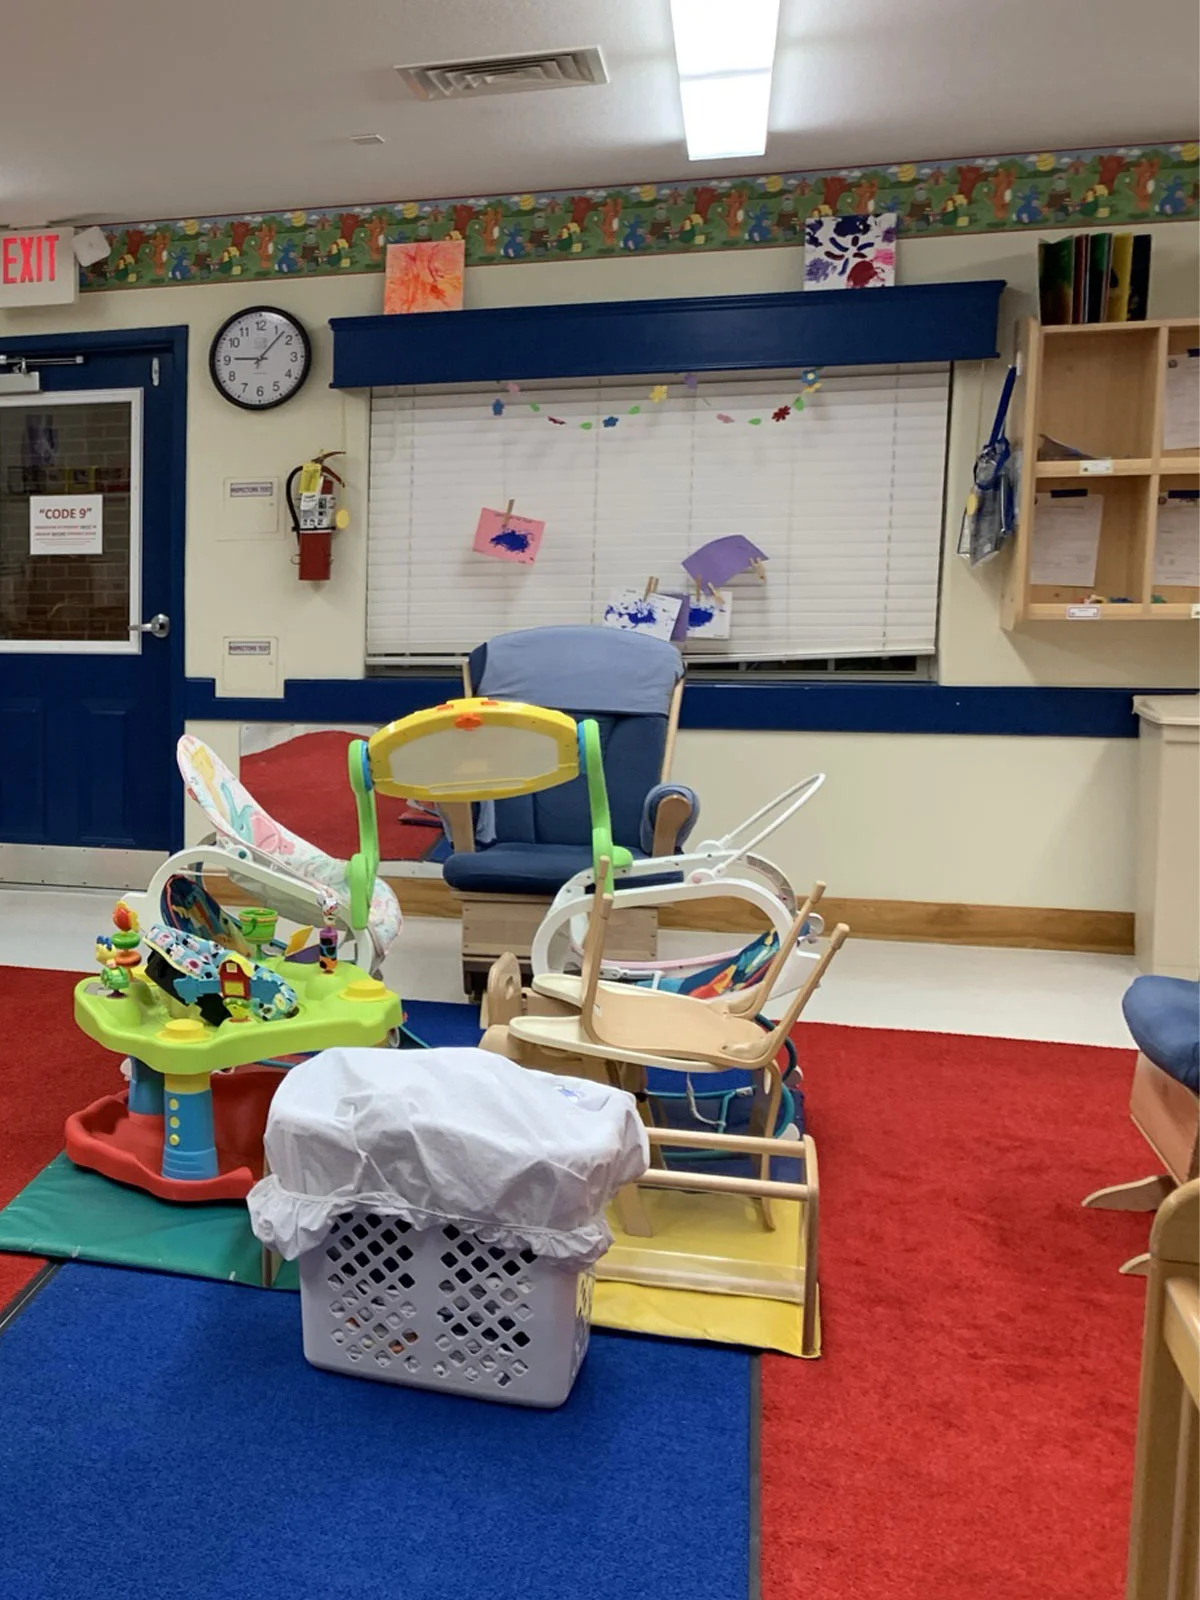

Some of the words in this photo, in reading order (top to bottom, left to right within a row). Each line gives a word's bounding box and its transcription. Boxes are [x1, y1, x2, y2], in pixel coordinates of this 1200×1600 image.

[2, 234, 60, 284] EXIT
[255, 320, 267, 331] 12
[240, 327, 249, 337] 11
[229, 338, 240, 348] 10
[285, 335, 293, 345] 2
[223, 355, 231, 366] 9
[290, 352, 298, 362] 3
[228, 371, 236, 381] 8
[285, 369, 292, 378] 4
[241, 383, 248, 393] 7
[272, 381, 280, 391] 5
[256, 386, 264, 397] 6
